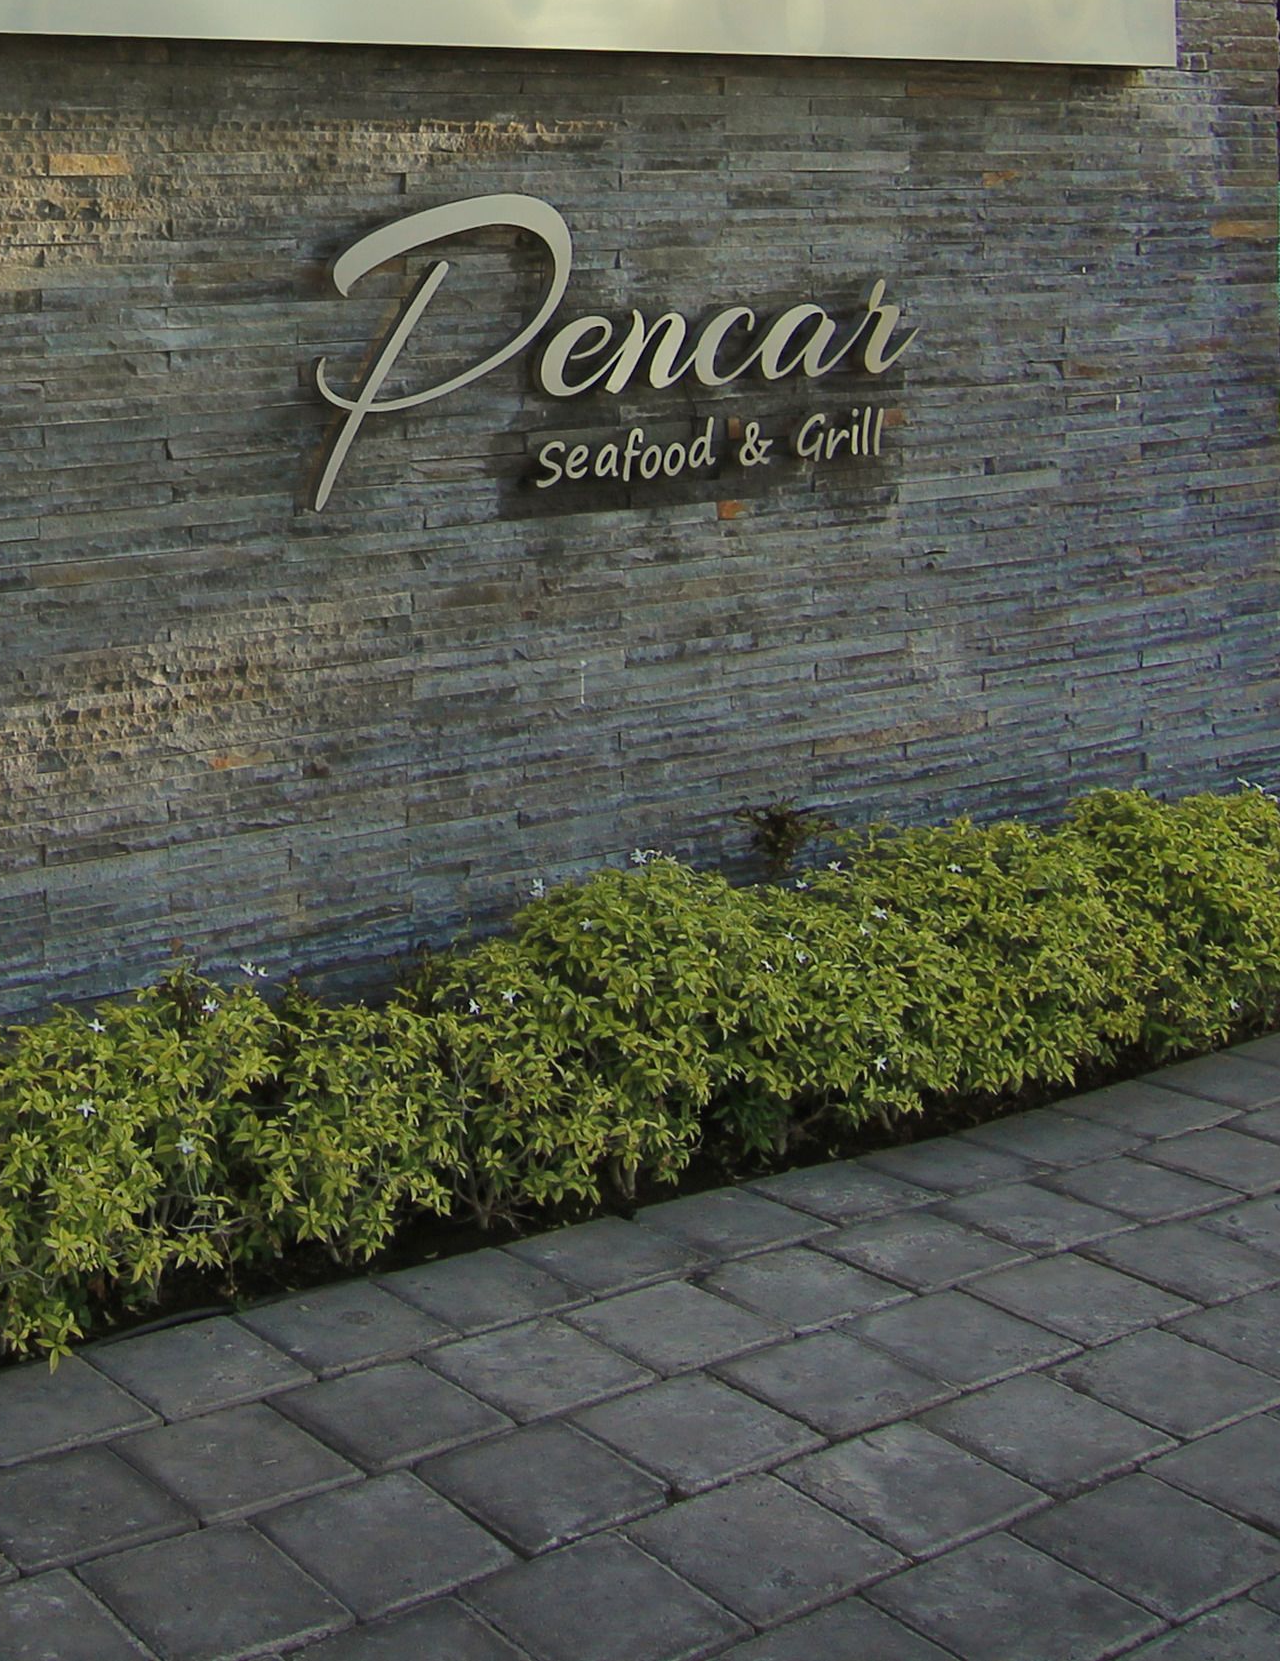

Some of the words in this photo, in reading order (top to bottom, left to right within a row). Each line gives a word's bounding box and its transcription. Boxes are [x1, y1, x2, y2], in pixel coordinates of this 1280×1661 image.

[316, 193, 919, 512] Pencar
[536, 417, 716, 489] Seafood
[738, 421, 772, 467] &
[796, 407, 884, 462] Grill
